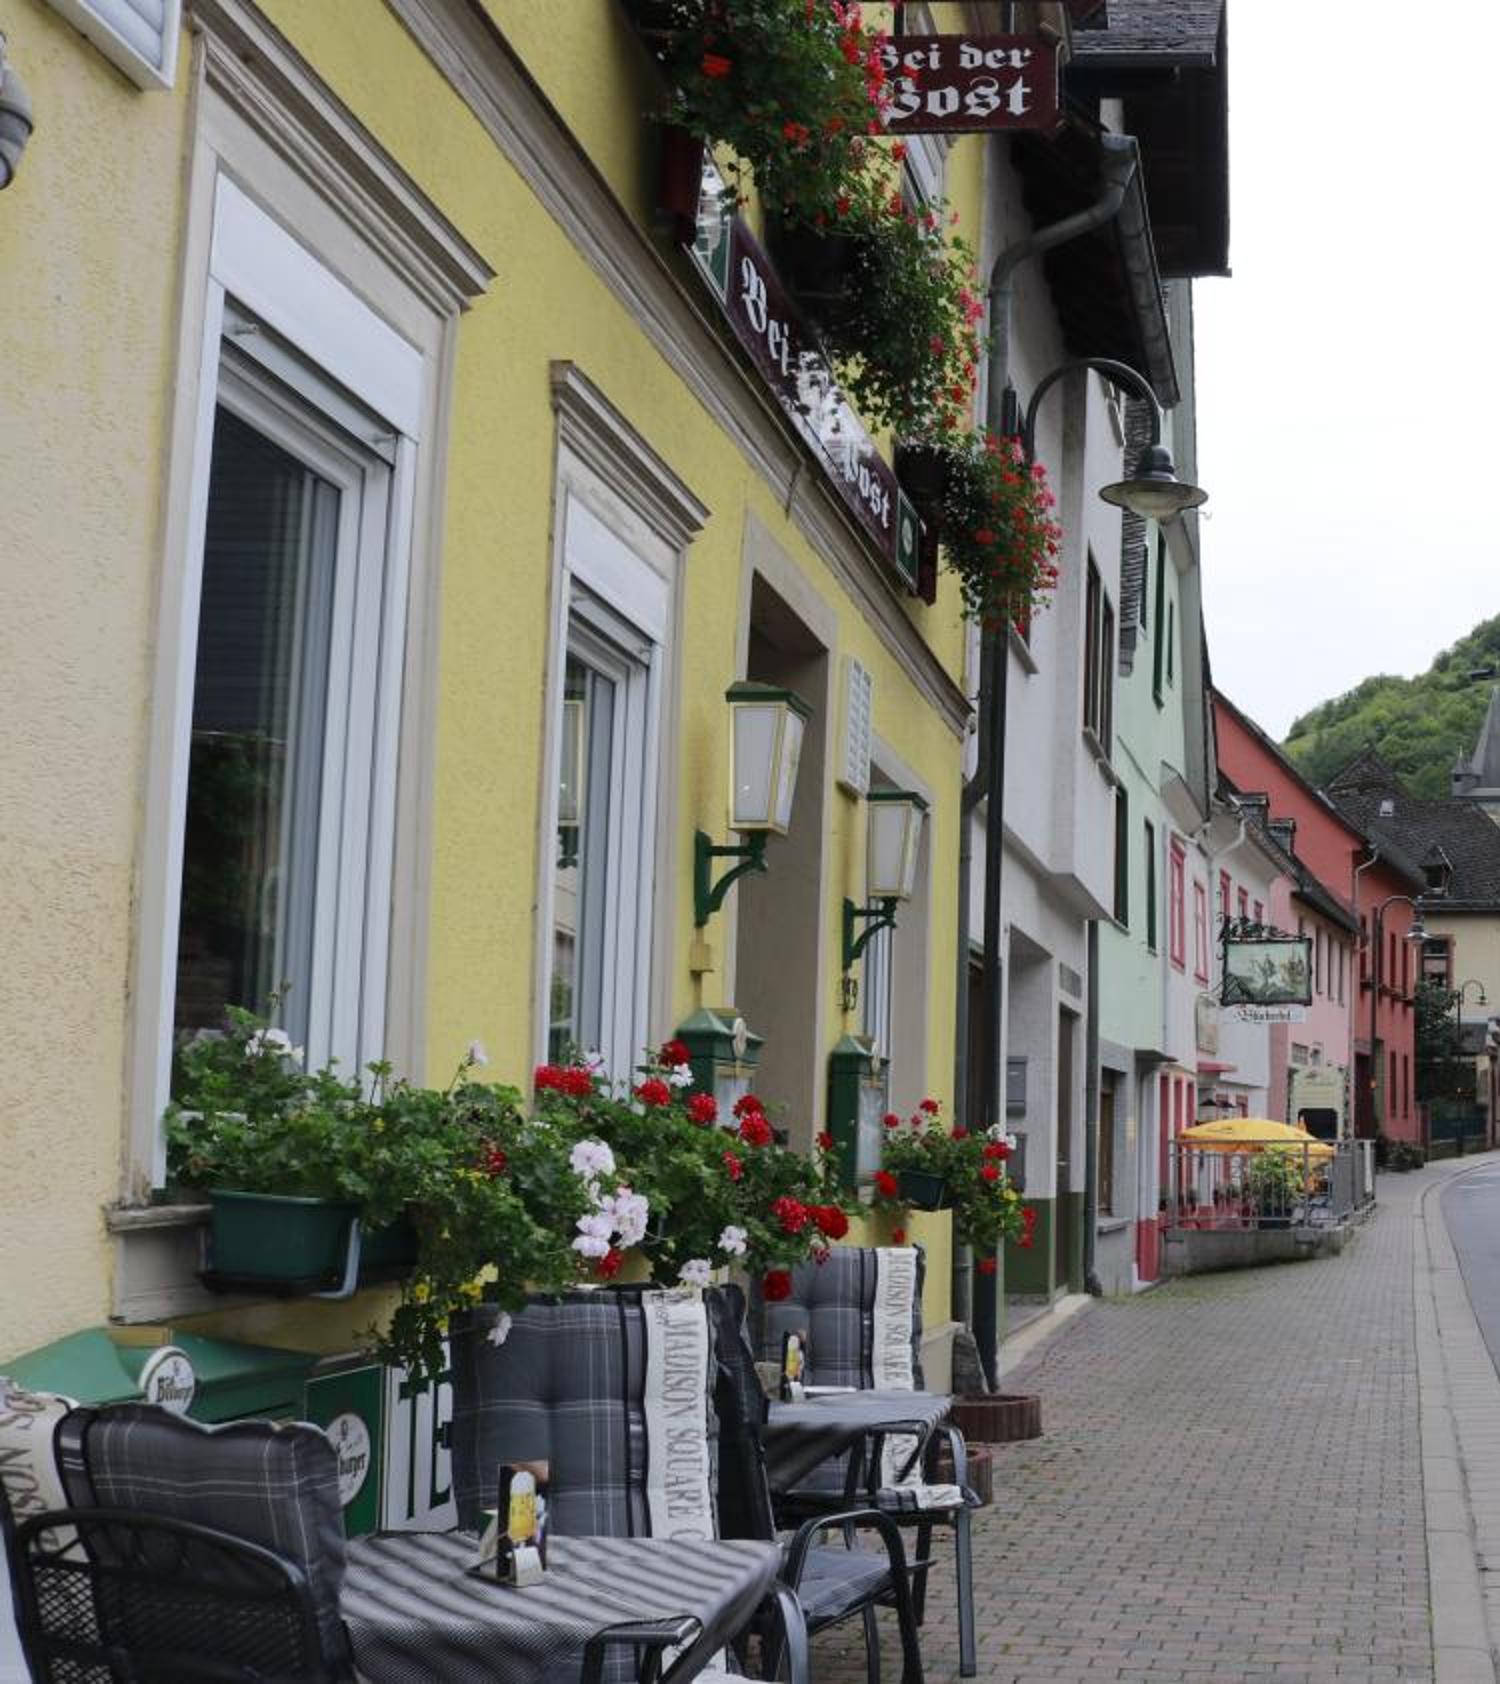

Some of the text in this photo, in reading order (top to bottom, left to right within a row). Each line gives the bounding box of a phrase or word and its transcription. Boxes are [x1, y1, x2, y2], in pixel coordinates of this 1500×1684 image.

[959, 42, 1033, 70] der
[742, 257, 790, 377] Bei
[661, 1319, 701, 1418] MADISON
[664, 1427, 706, 1520] SQUARE
